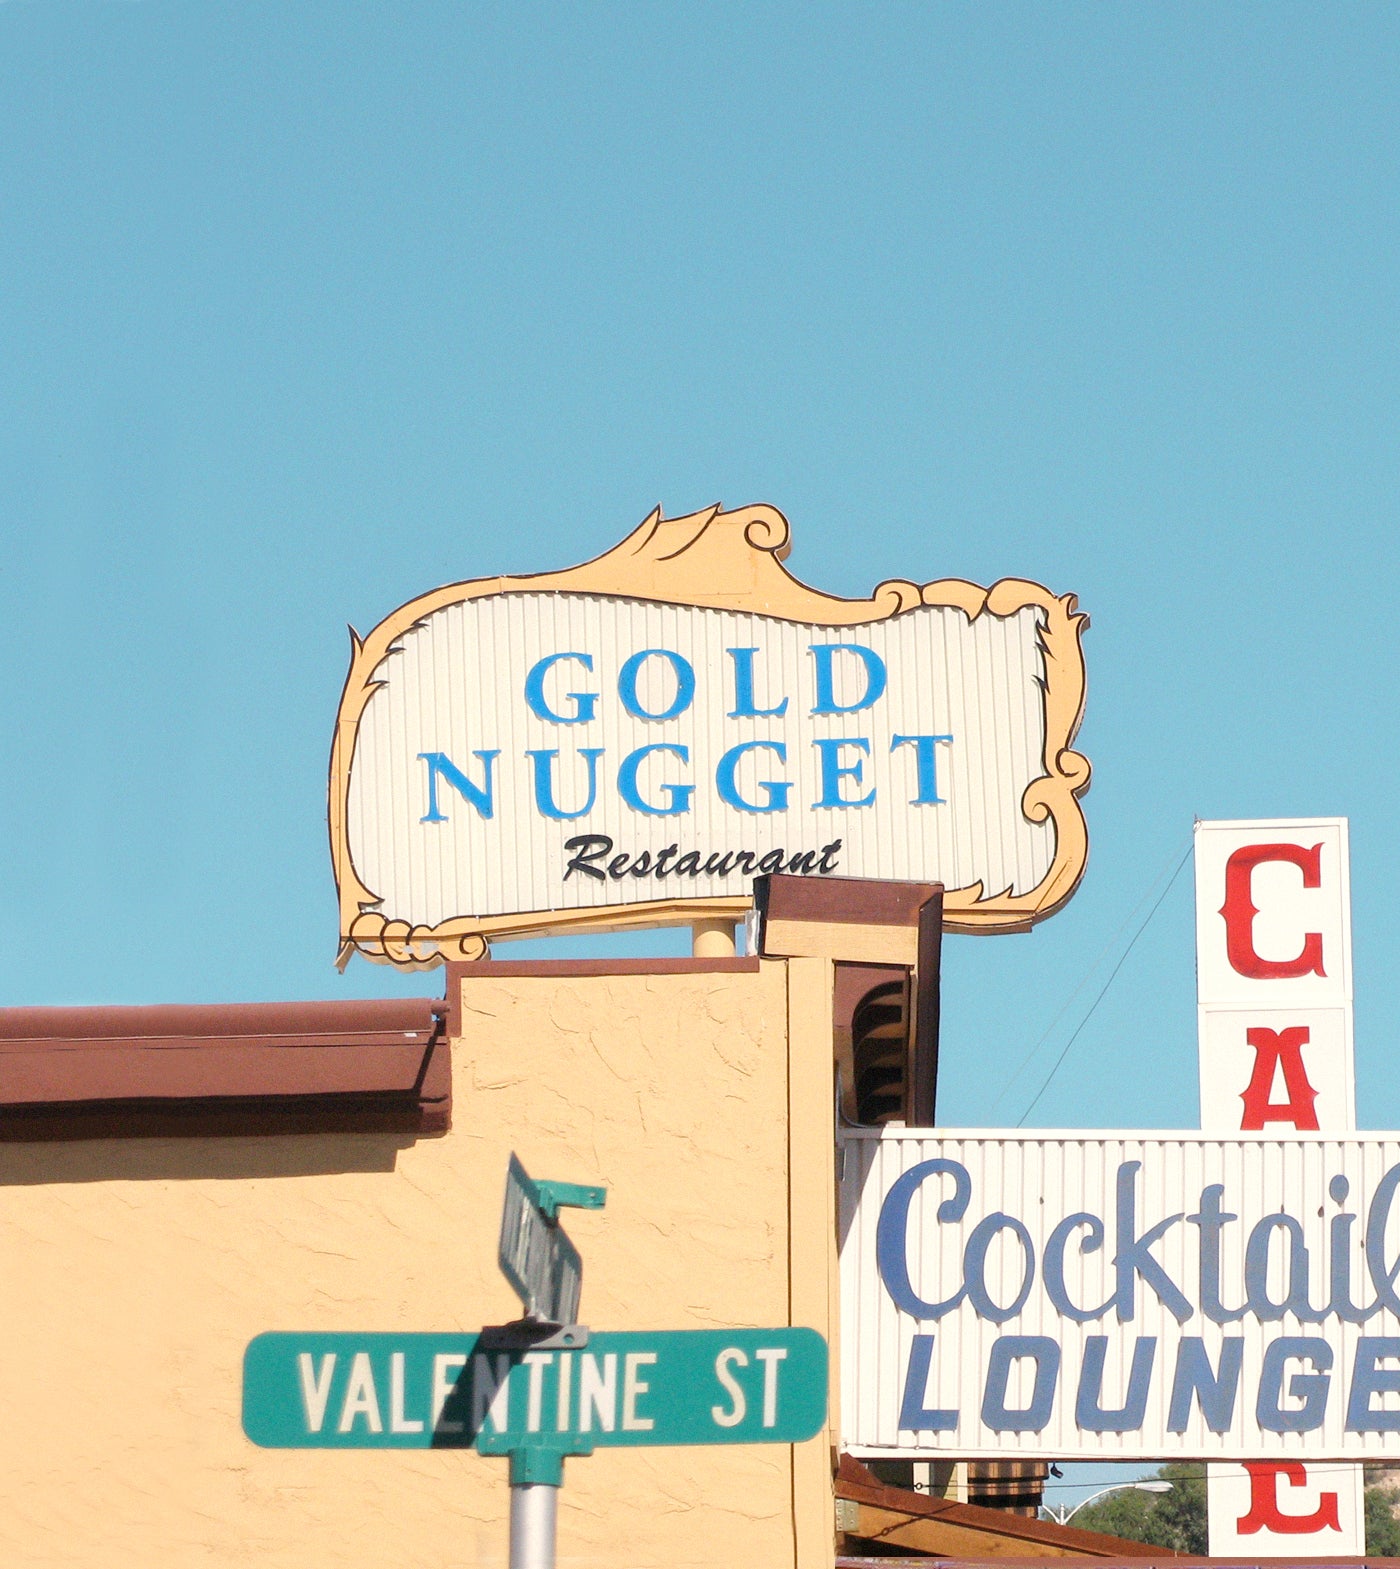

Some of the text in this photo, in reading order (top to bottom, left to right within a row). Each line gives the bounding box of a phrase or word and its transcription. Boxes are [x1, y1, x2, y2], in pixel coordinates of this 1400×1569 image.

[524, 643, 888, 724] GOLD
[418, 734, 954, 822] NUGGET
[564, 834, 842, 881] Restaurant
[299, 1347, 788, 1434] VALENTINE ST
